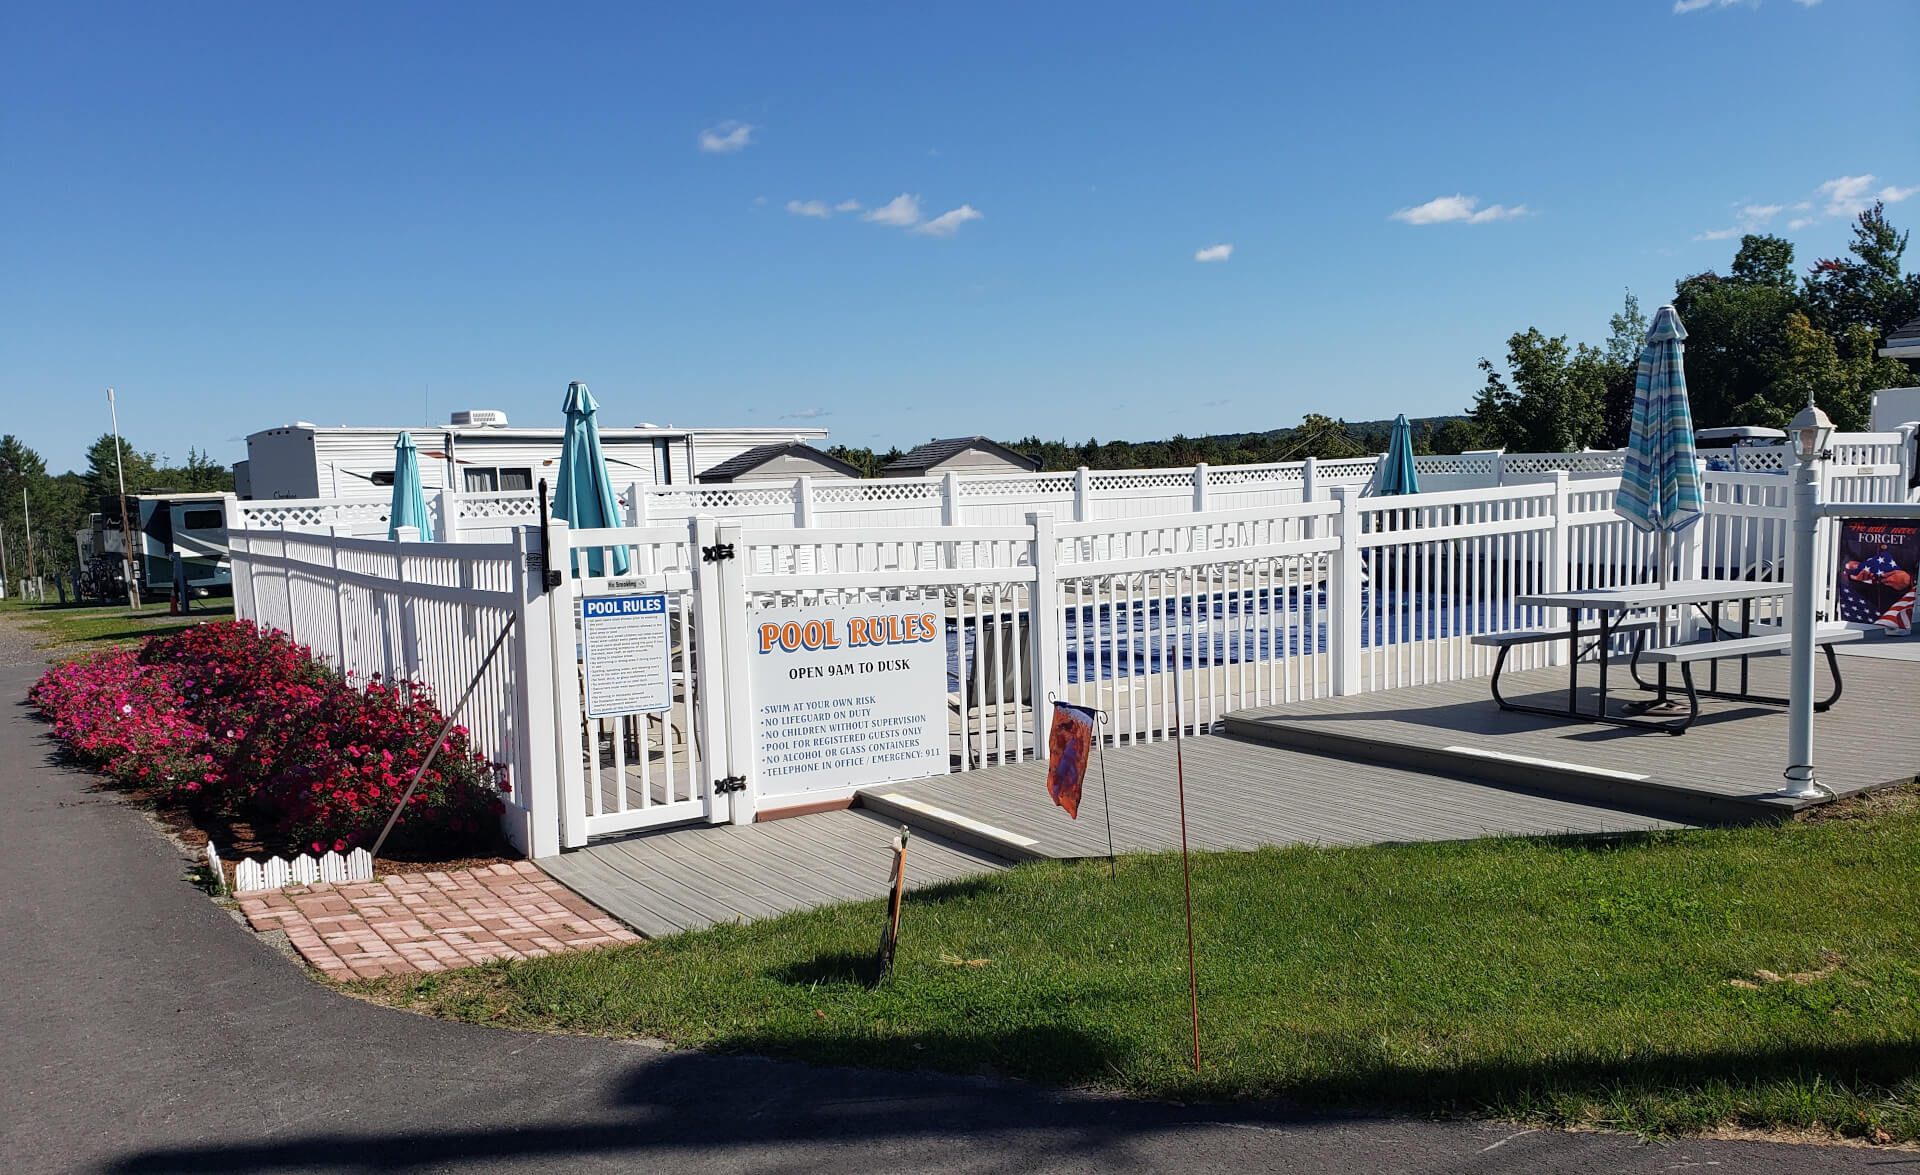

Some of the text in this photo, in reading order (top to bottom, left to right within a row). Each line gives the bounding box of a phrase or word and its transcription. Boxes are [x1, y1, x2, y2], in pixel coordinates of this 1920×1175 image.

[1858, 532, 1906, 544] FORGET
[588, 599, 661, 614] POOL RULES
[758, 612, 937, 654] POOL RULES
[789, 658, 910, 680] OPEN 9AM TO DUSK
[765, 696, 876, 714] SWIM AT YOUR OWN RISK
[766, 708, 871, 726] NO LIFEGUARD ON DUTY
[766, 715, 926, 739] NO CHILDREN WITHOUT SUPERVISION
[766, 727, 922, 751] POOL FOR REGISTERED GUESTS ONLY
[766, 739, 920, 764] NO ALCOHOL OR GLASS CONTAINERS
[768, 763, 819, 776] TELEPHONE
[822, 761, 831, 769] IN
[834, 757, 864, 768] OFFICE
[872, 751, 923, 764] EMERGENCY:
[926, 748, 940, 757] 911
